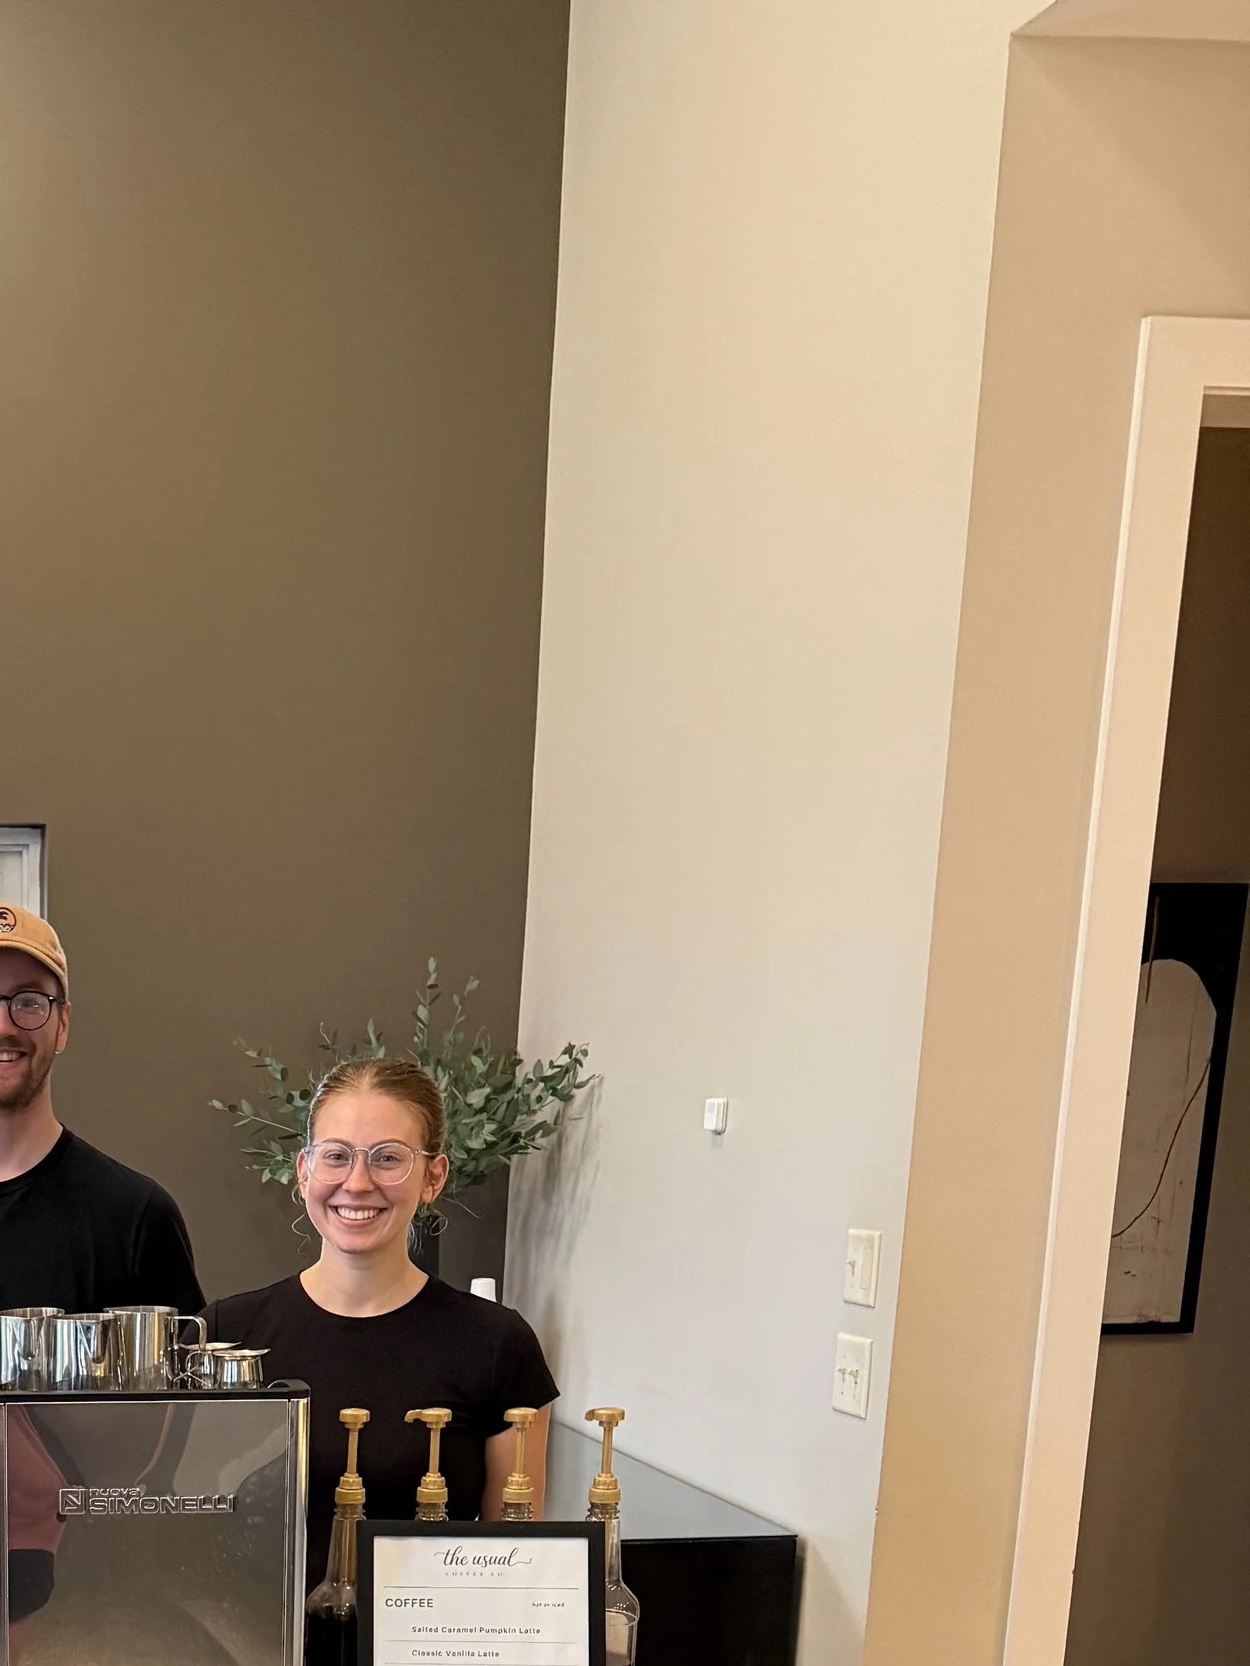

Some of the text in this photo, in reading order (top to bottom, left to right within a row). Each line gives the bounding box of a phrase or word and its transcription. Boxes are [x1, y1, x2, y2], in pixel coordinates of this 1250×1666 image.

[89, 1487, 140, 1496] nuova
[89, 1494, 236, 1515] SIMONELLI
[434, 1545, 532, 1568] the usual
[385, 1598, 434, 1608] COFFEE
[479, 1626, 517, 1635] Pumpkin
[411, 1649, 442, 1657] Classic
